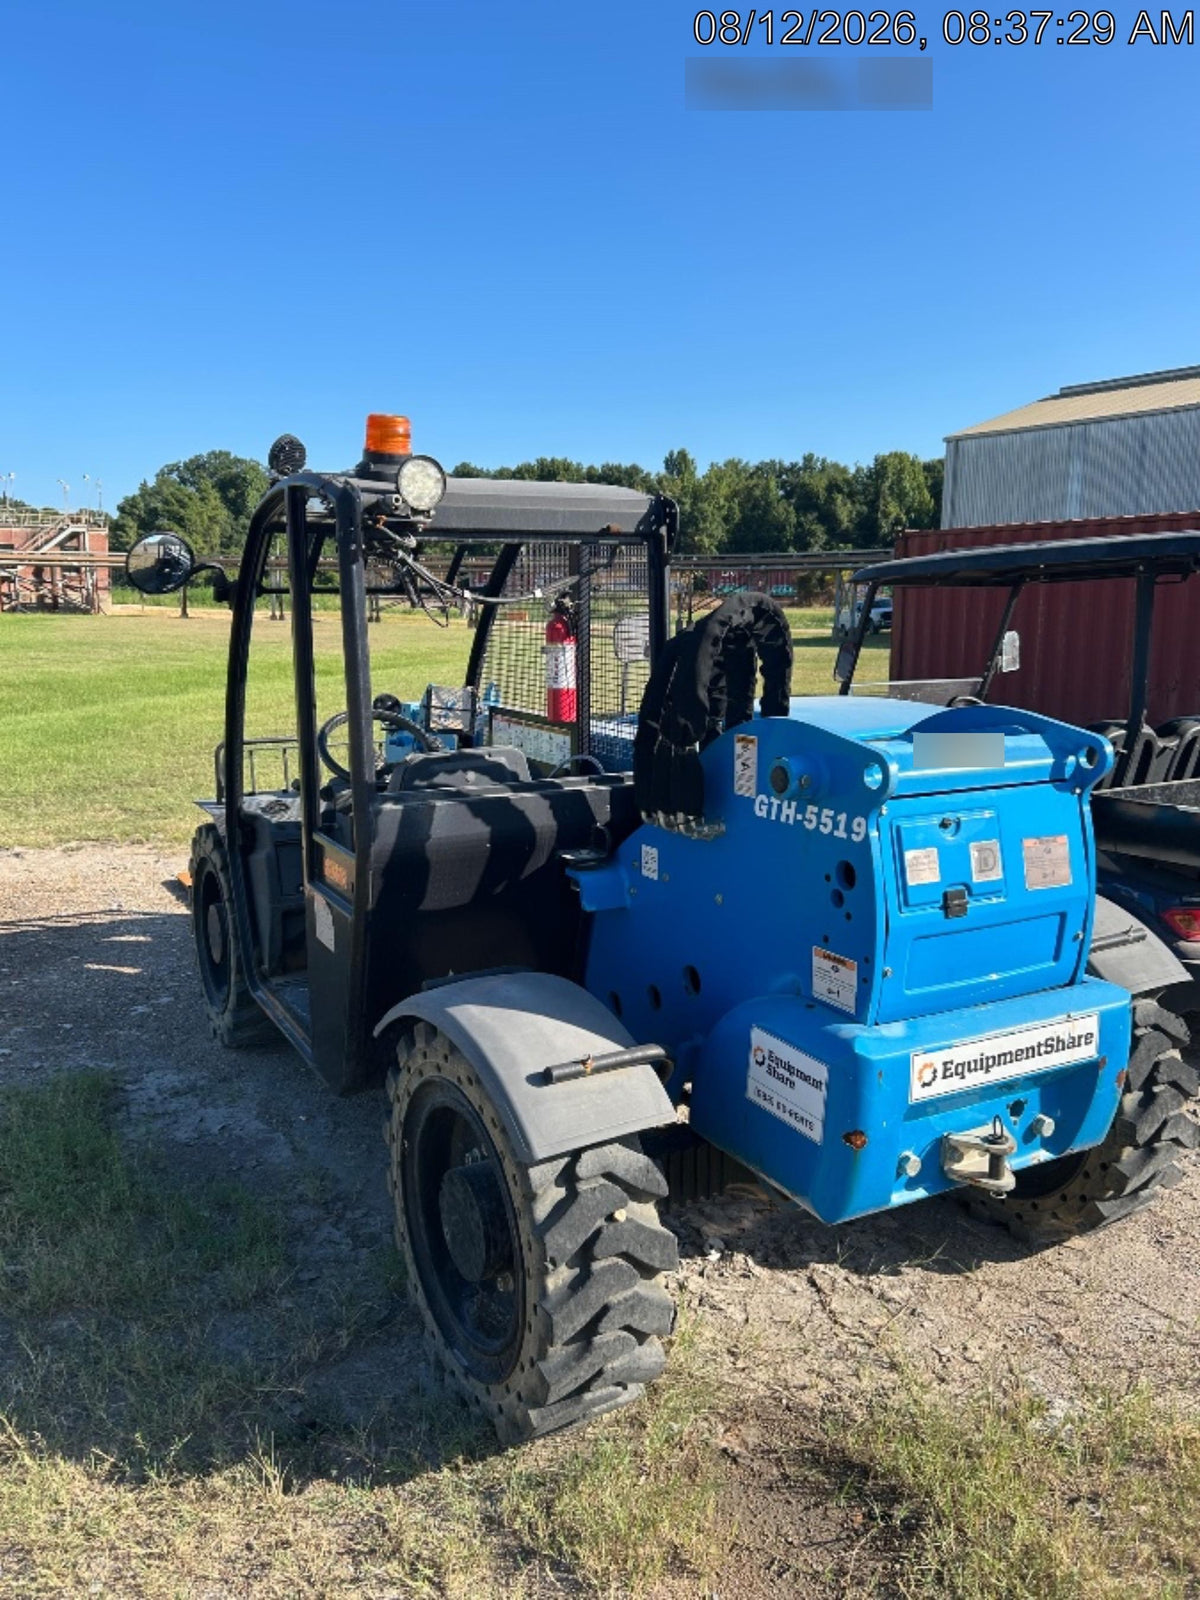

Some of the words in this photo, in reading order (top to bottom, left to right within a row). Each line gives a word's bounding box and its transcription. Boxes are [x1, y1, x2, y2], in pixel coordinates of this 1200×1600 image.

[754, 794, 867, 842] GTH-5519
[766, 1062, 796, 1090] Share
[767, 1048, 824, 1093] Equipment
[941, 1031, 1095, 1081] EquipmentShare
